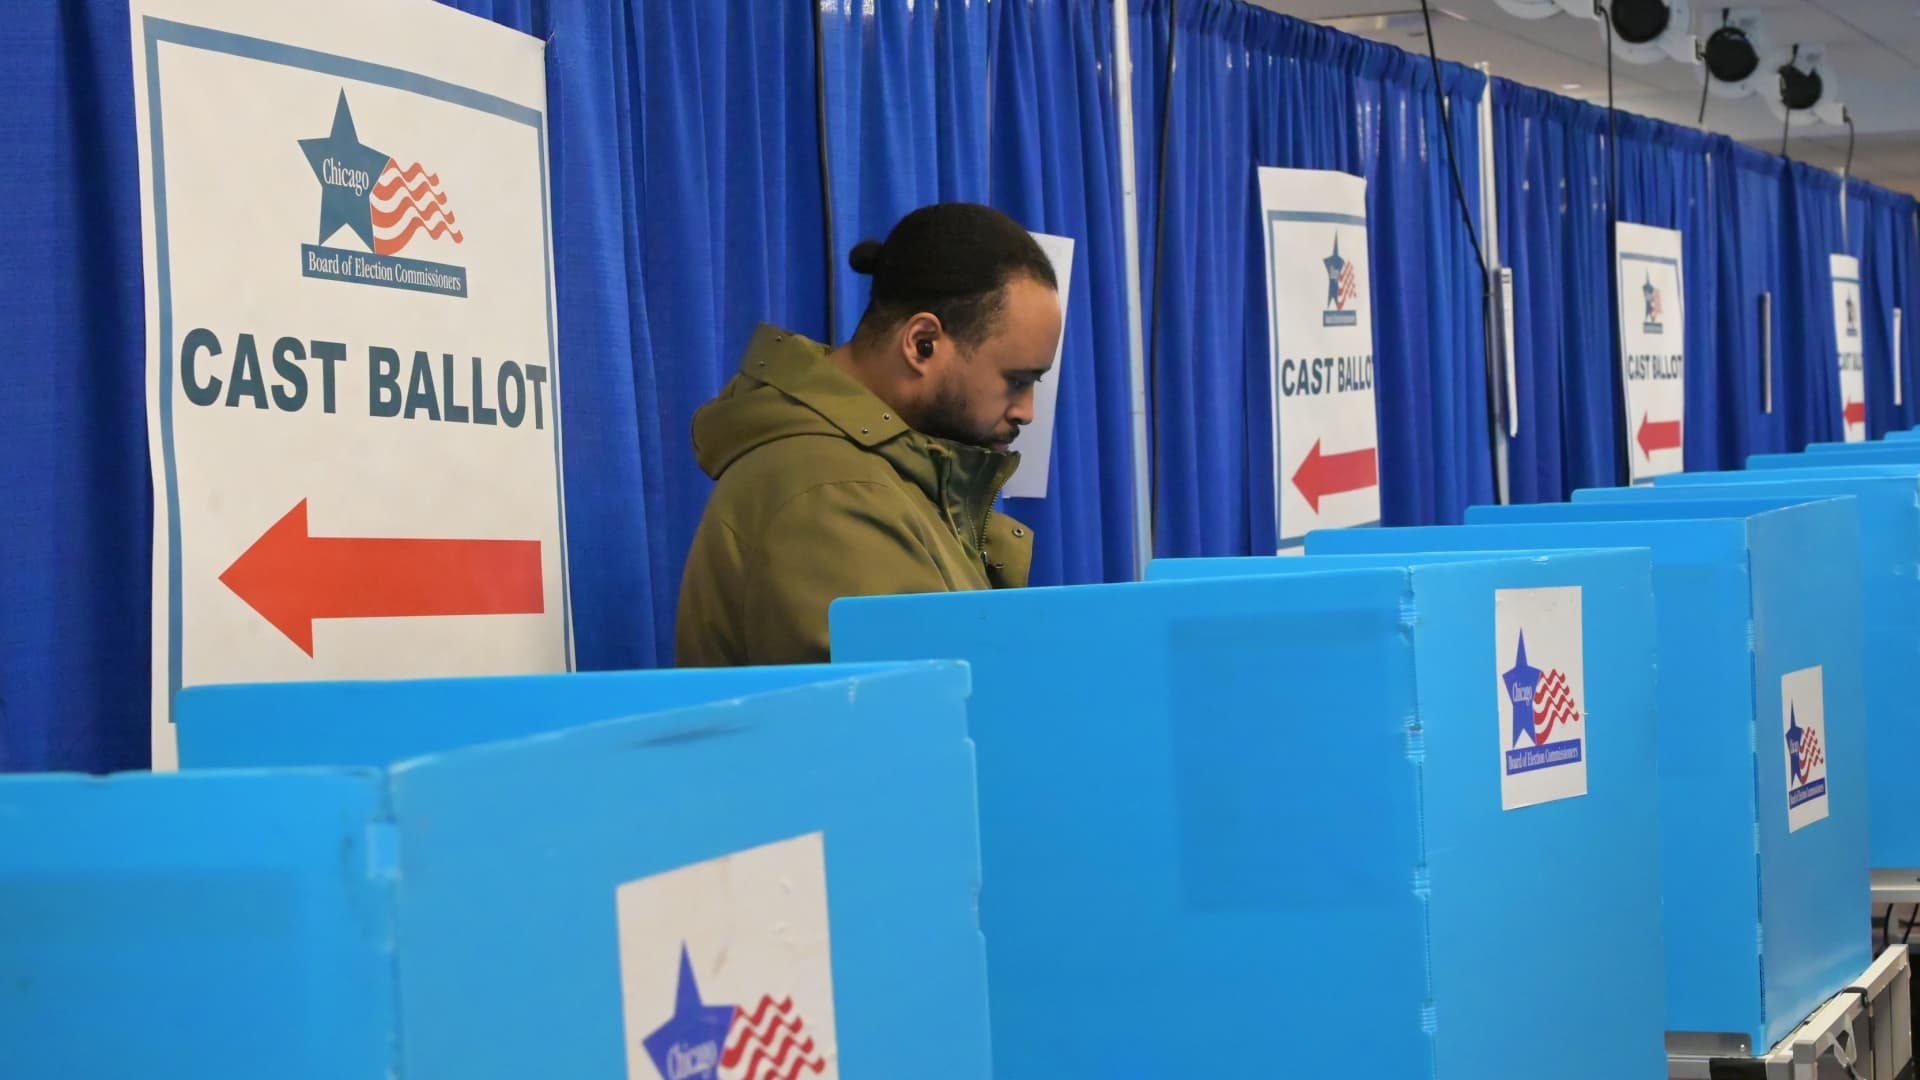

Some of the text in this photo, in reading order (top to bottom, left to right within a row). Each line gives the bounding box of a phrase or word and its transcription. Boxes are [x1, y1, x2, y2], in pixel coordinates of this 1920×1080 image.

[322, 157, 370, 197] Chicago
[308, 251, 461, 291] Board of Election Commissioners
[180, 328, 547, 430] CAST BALLOT
[1282, 355, 1373, 397] CAST BALLO
[1628, 354, 1650, 380] CAST
